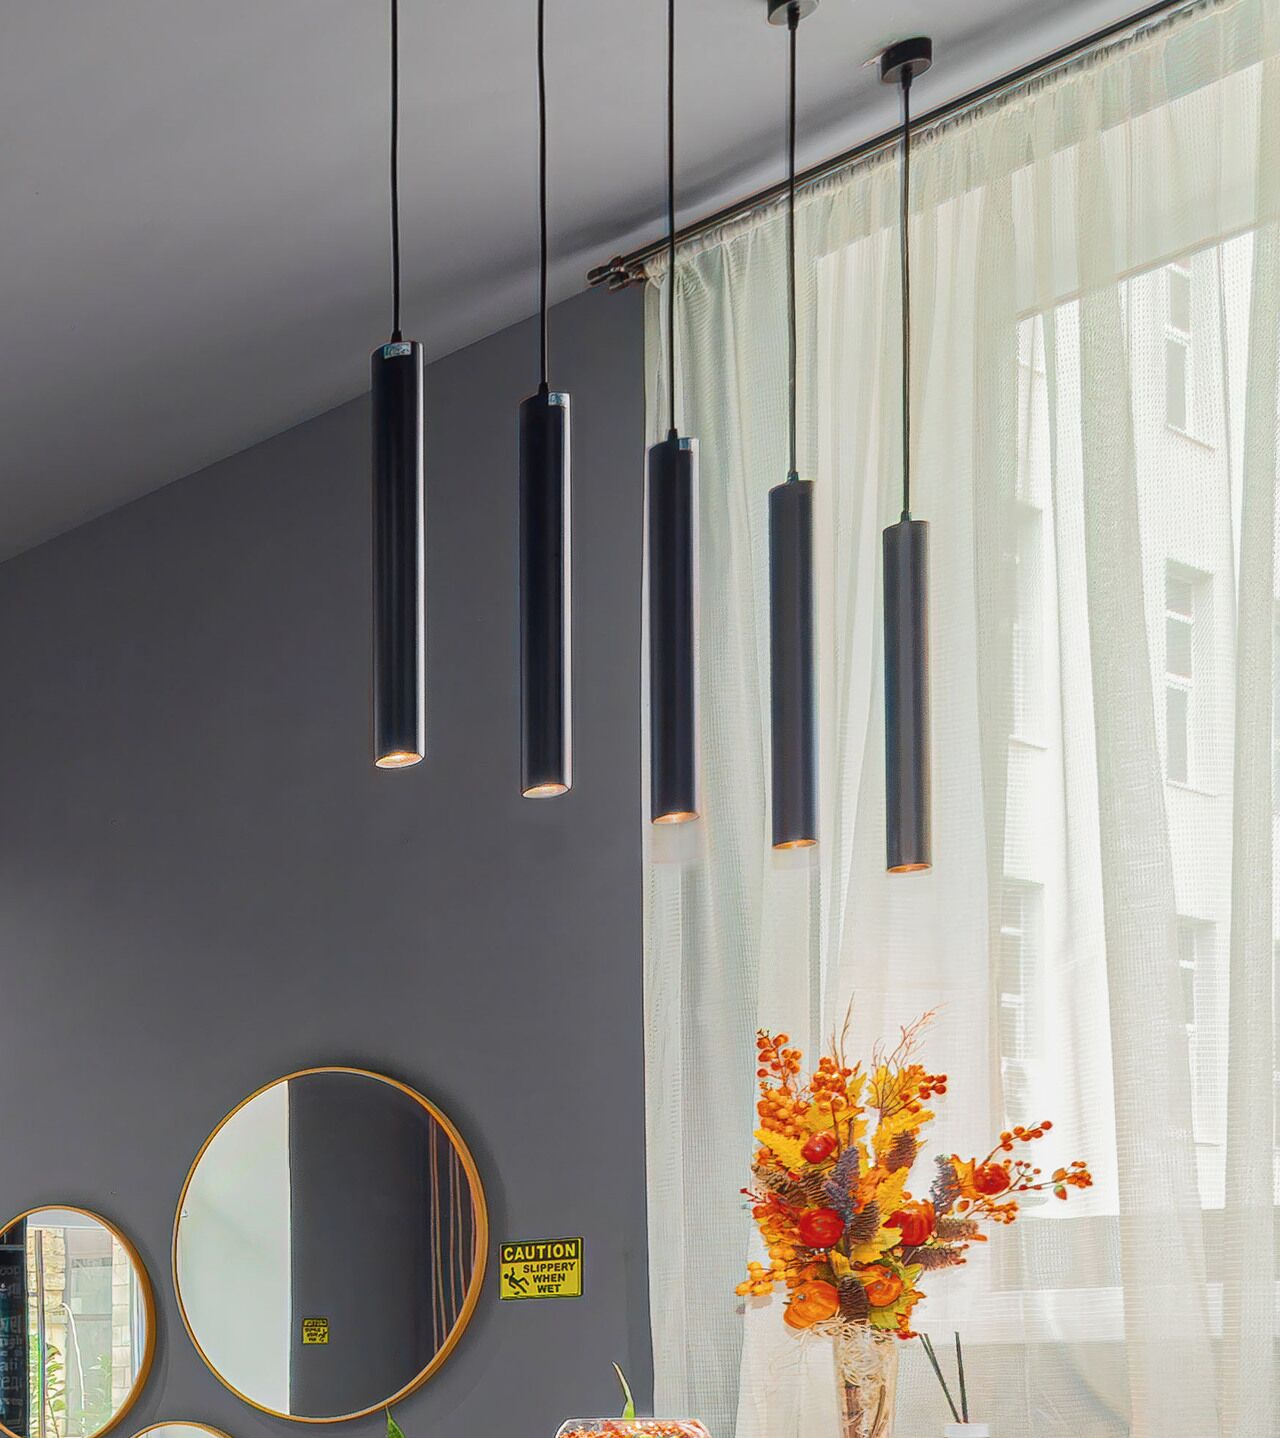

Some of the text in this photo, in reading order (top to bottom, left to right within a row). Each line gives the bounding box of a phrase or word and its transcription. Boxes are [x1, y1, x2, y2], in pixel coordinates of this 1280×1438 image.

[504, 1243, 576, 1261] CAUTION
[523, 1262, 576, 1273] SLIPPERY
[532, 1273, 566, 1283] WHEN
[537, 1284, 561, 1293] WET
